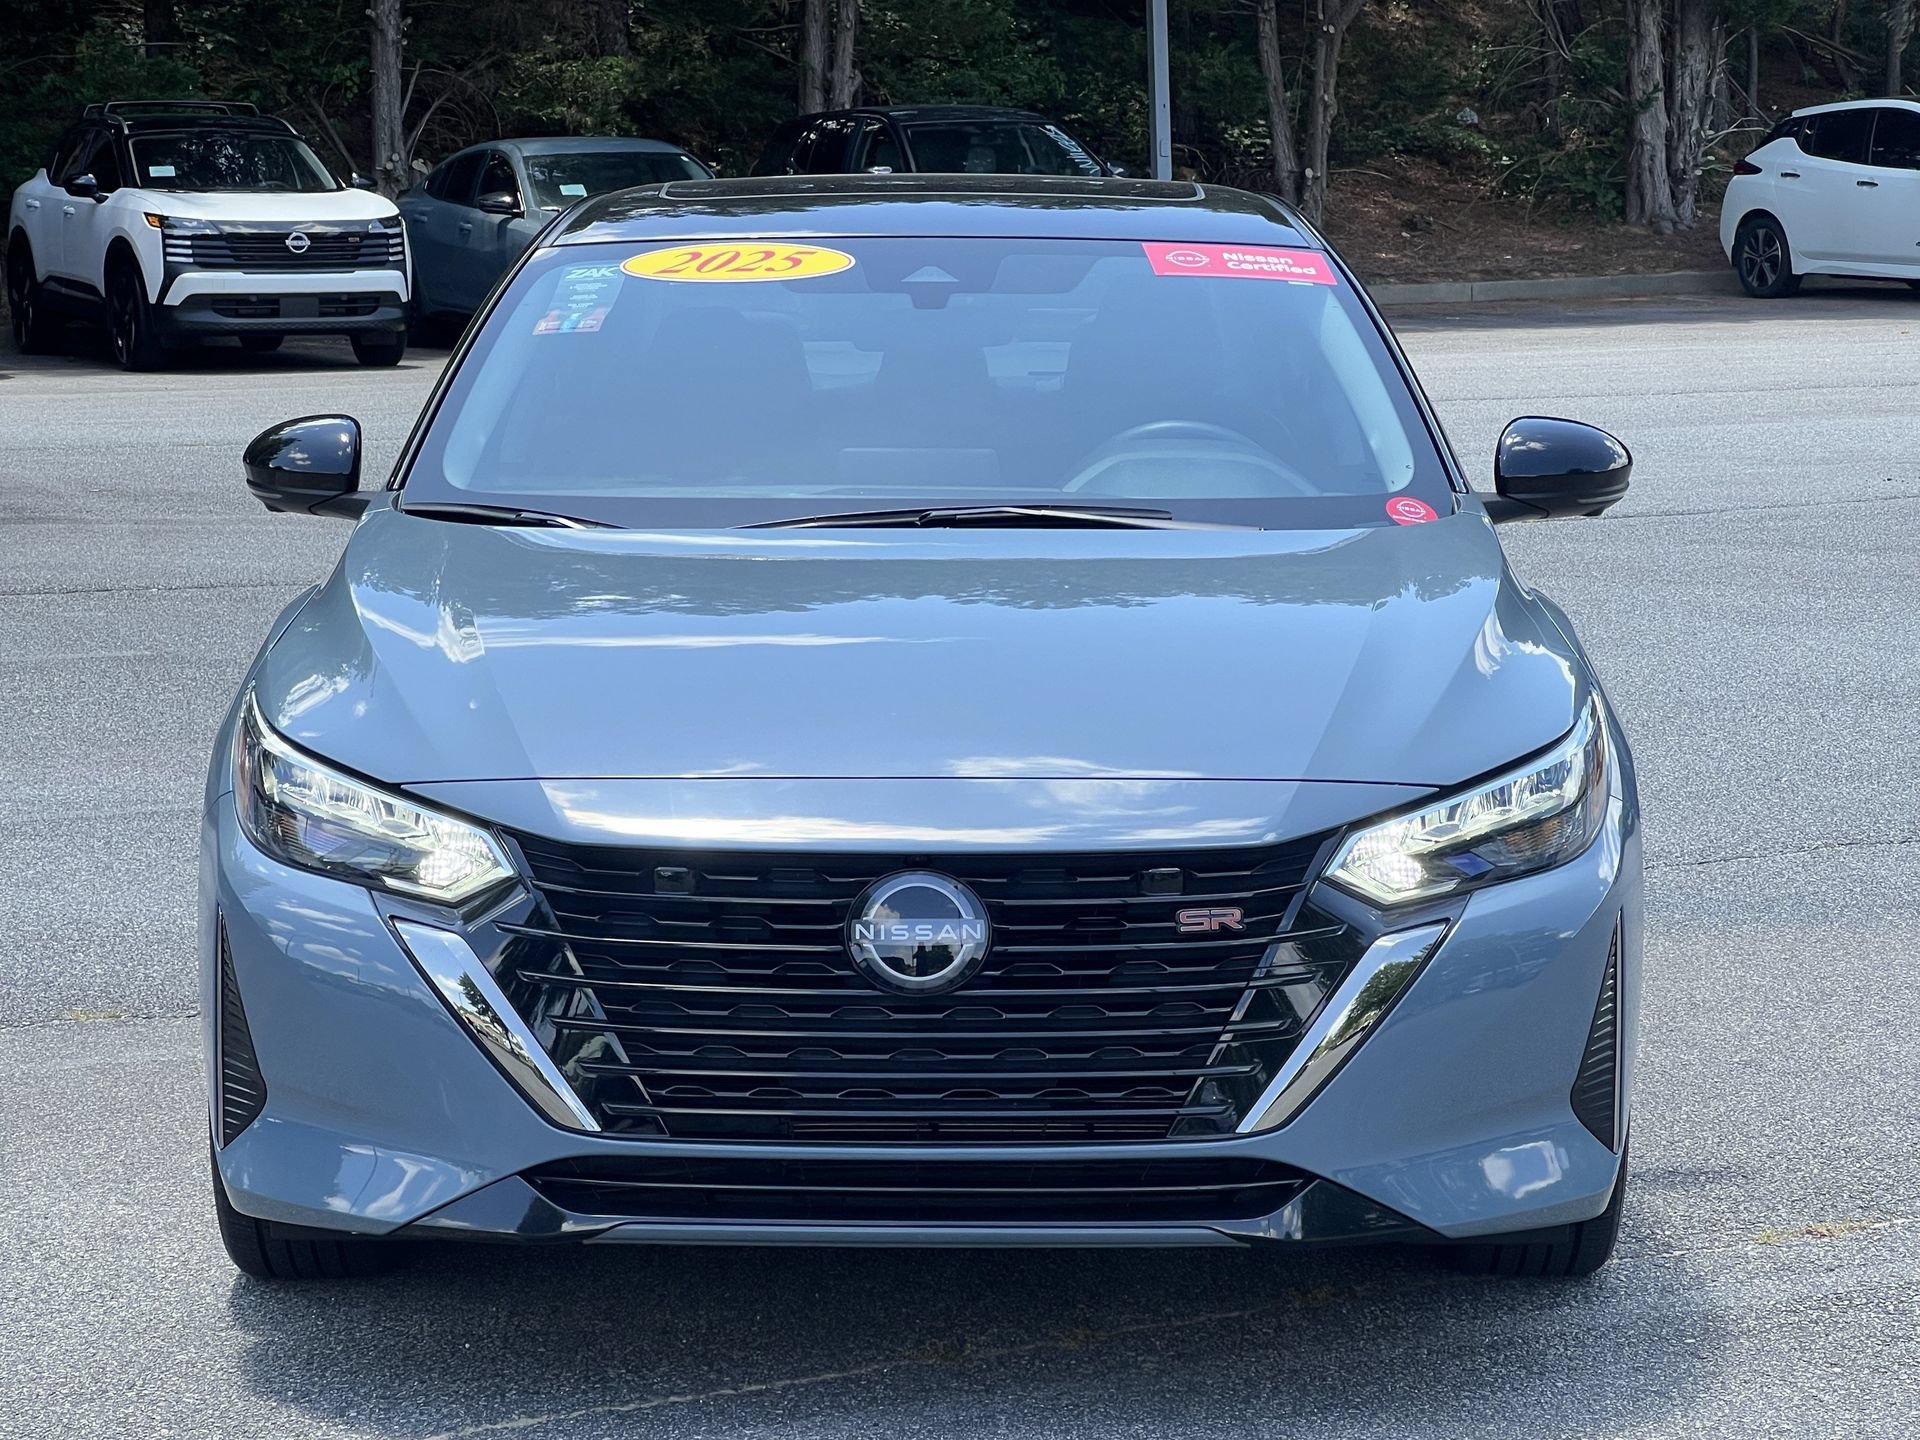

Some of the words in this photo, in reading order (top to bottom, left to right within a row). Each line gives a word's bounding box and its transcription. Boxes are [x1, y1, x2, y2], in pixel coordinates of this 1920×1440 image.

[653, 250, 819, 274] 2025
[1223, 252, 1293, 264] Nissan
[565, 266, 619, 279] ZAK
[1227, 262, 1316, 275] Certified
[1177, 908, 1244, 933] SR
[854, 922, 984, 941] NISSAN
